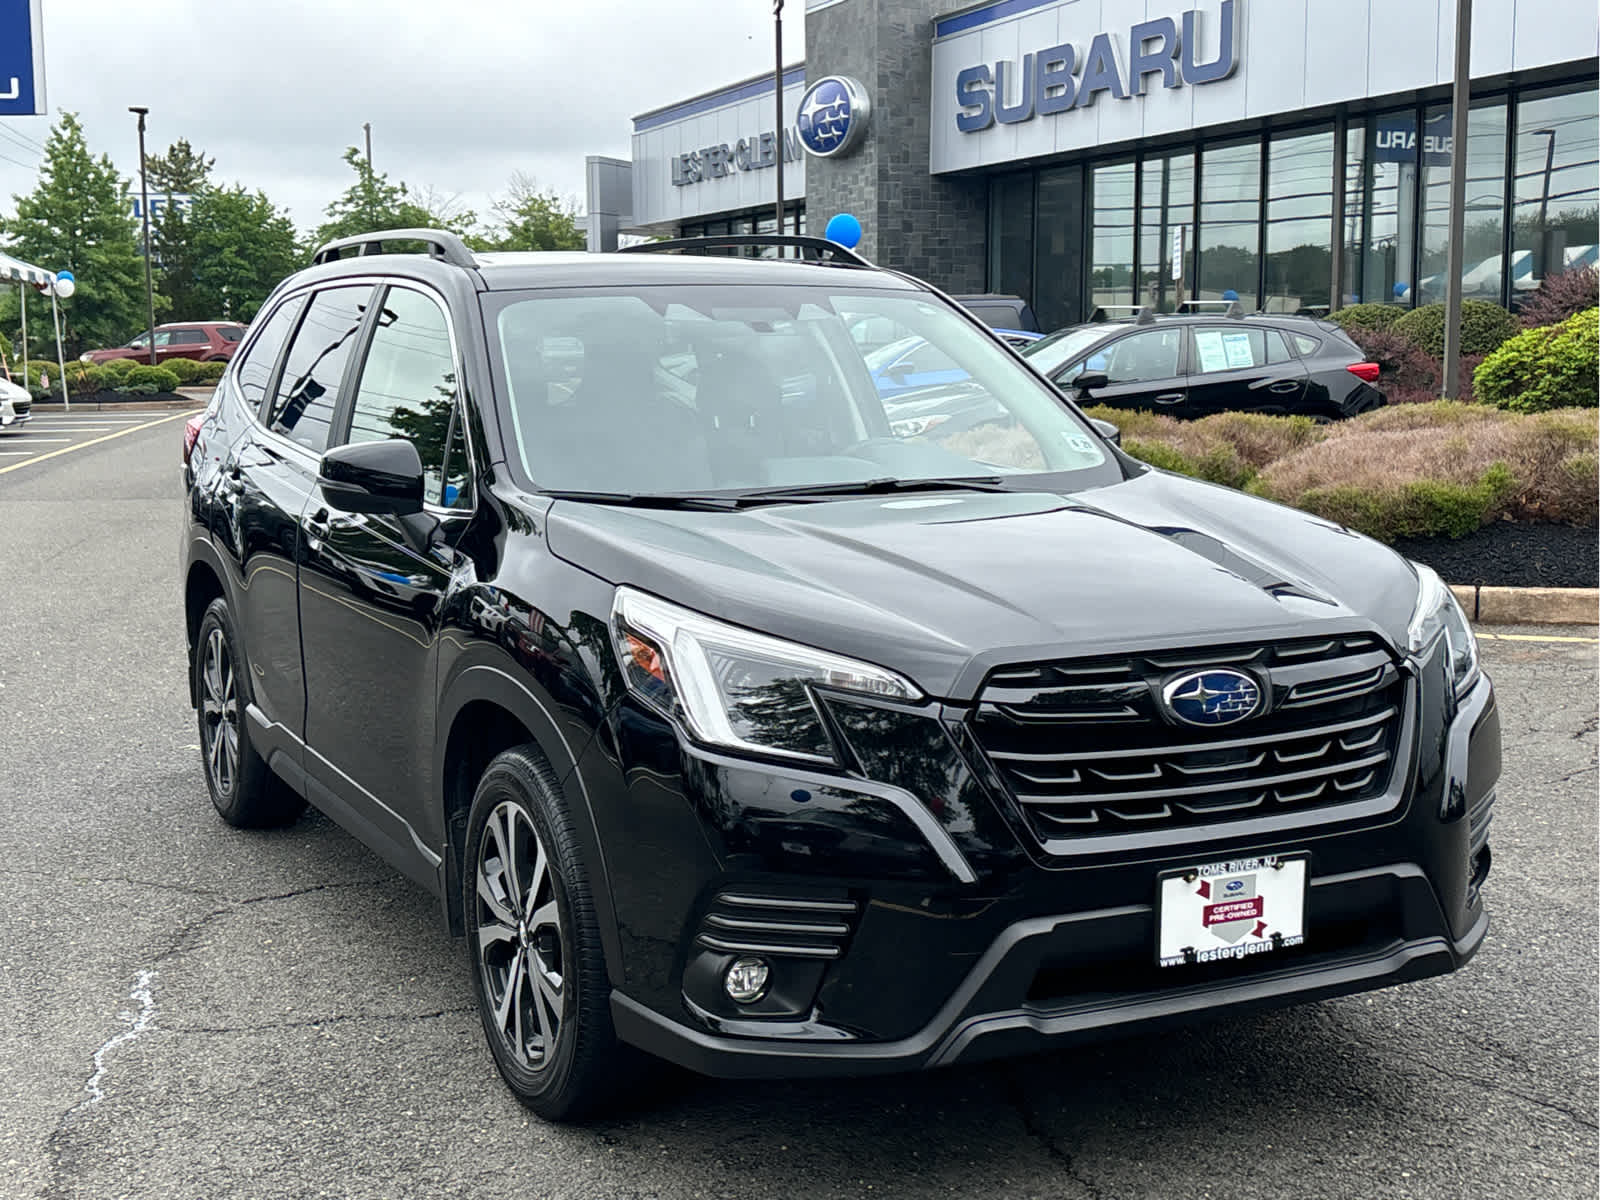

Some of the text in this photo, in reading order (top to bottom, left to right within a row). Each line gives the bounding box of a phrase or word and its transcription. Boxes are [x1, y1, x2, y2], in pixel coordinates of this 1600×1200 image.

[956, 0, 1239, 132] SUBARU
[672, 143, 735, 187] LESTER
[1198, 863, 1227, 876] TOMS
[1264, 856, 1278, 868] NJ
[1209, 908, 1258, 922] PRE-OWNED
[1213, 901, 1254, 914] CERTIFIED
